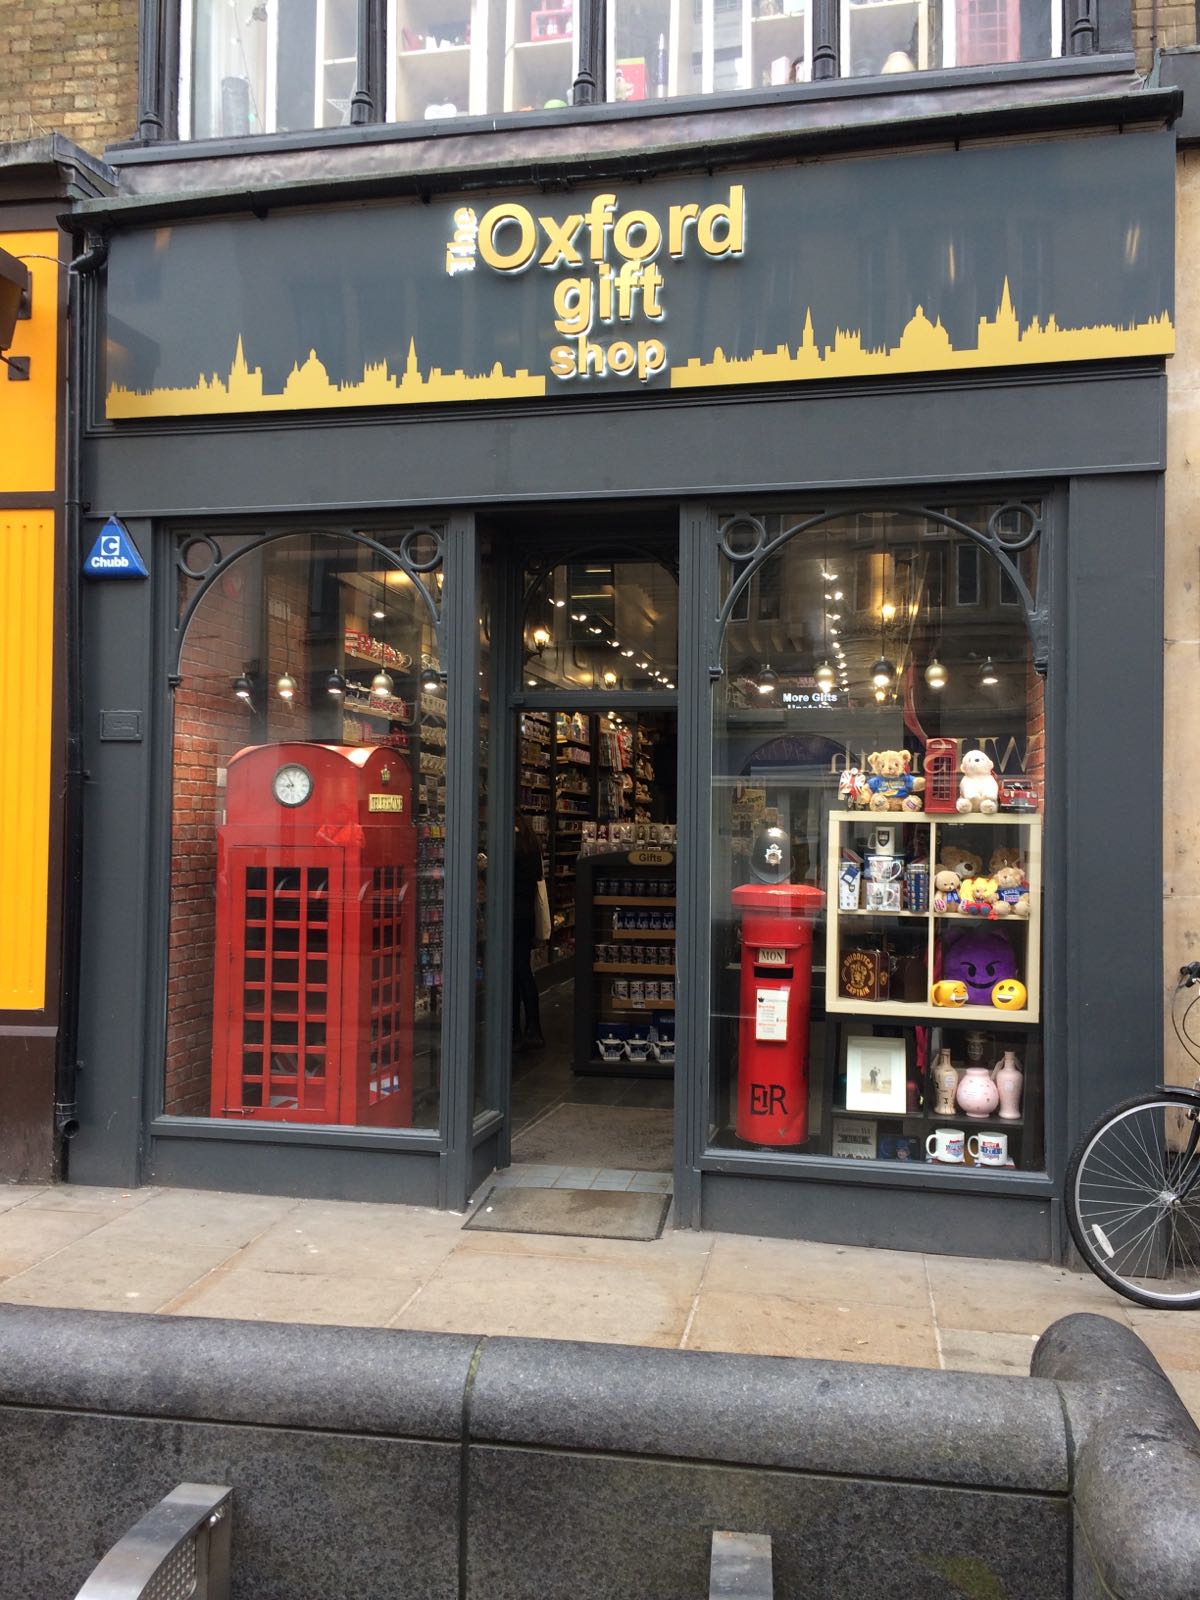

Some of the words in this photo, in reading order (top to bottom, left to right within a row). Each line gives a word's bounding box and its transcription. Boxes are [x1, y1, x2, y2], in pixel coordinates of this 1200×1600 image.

[446, 207, 477, 276] The
[478, 185, 745, 270] Oxford
[553, 260, 663, 337] gift
[550, 336, 667, 381] shop
[91, 556, 129, 568] Chubb
[782, 692, 810, 703] More
[811, 692, 838, 702] Gifts
[639, 852, 663, 863] Gifts
[761, 950, 784, 961] MON
[846, 983, 870, 997] CAPTAIN
